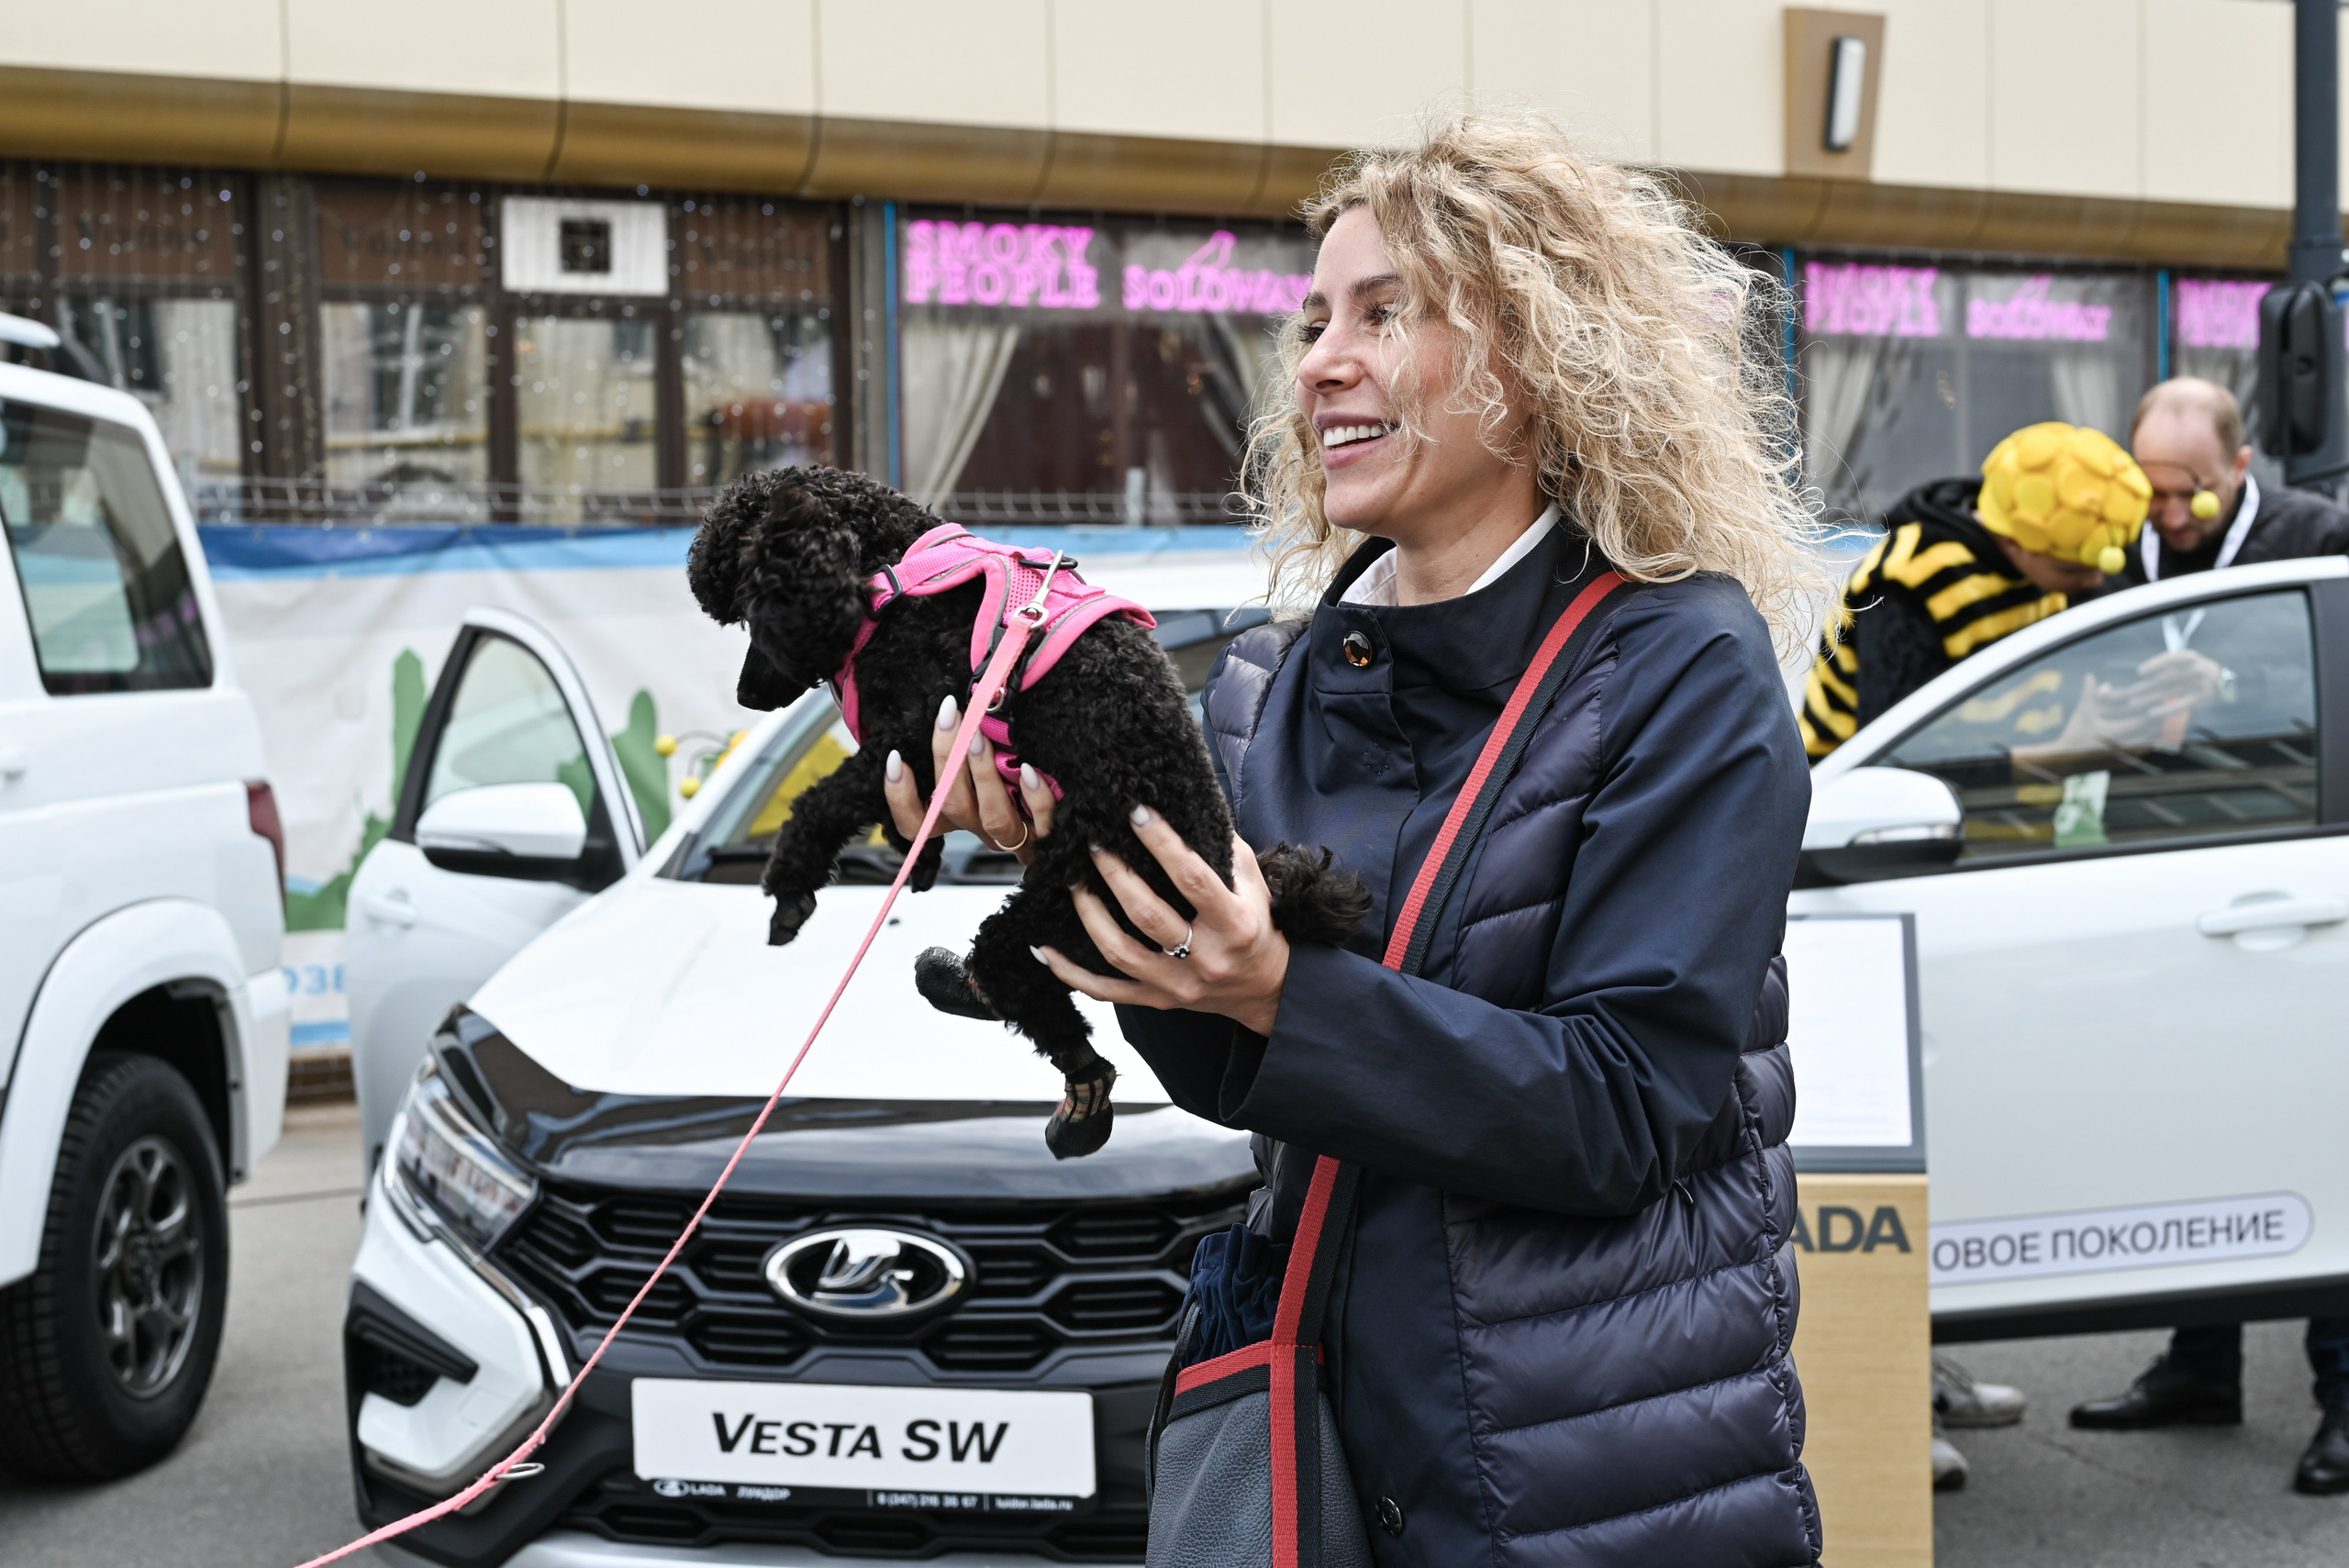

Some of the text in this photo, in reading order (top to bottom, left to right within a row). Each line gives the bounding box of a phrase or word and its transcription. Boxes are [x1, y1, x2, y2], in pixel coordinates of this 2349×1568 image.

[907, 220, 1096, 262] SMOKY
[905, 262, 1100, 308] PEOPLE
[1790, 1206, 1912, 1253] ADA
[1932, 1208, 2286, 1273] ОВОЕ ПОКОЛЕНИЕ
[712, 1412, 1010, 1463] VESTA SW
[690, 1483, 726, 1497] LADA
